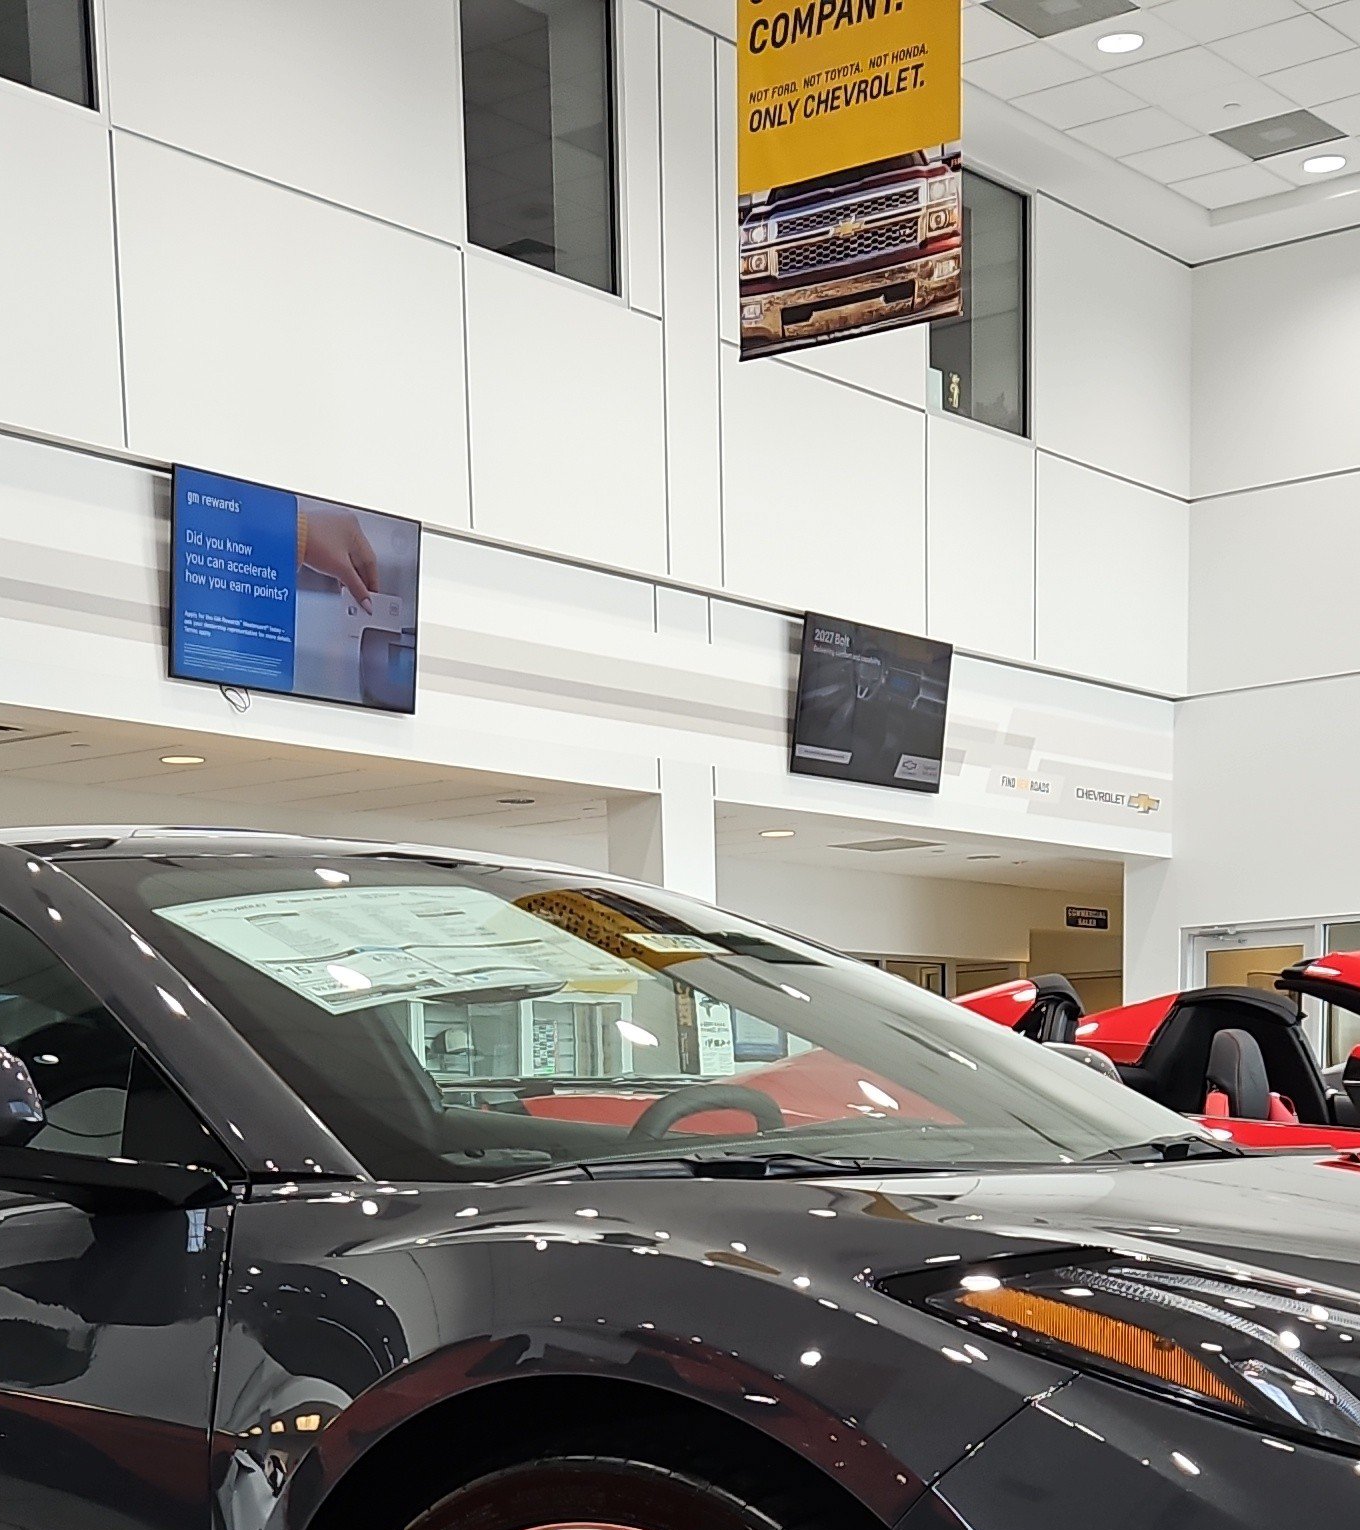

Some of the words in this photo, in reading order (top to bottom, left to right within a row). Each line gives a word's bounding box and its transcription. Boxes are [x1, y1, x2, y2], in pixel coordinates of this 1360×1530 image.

[749, 88, 770, 105] NOT
[771, 81, 799, 98] FORD.
[803, 72, 823, 89] NOT
[825, 61, 863, 82] TOYOTA.
[869, 52, 889, 69] NOT
[891, 43, 928, 64] HONDA.
[749, 97, 800, 133] ONLY
[803, 62, 925, 119] CHEVROLET.
[187, 491, 199, 505] gm
[186, 529, 203, 545] Did
[206, 536, 224, 550] you
[226, 538, 252, 556] know
[185, 551, 204, 566] you
[206, 556, 225, 569] can
[227, 560, 277, 581] accelerate
[185, 568, 206, 585] how
[209, 575, 226, 589] you
[229, 580, 252, 594] earn
[254, 584, 289, 601] points?
[814, 628, 835, 643] 2027
[834, 633, 850, 647] Bolt
[1076, 787, 1125, 805] CHEVROLET
